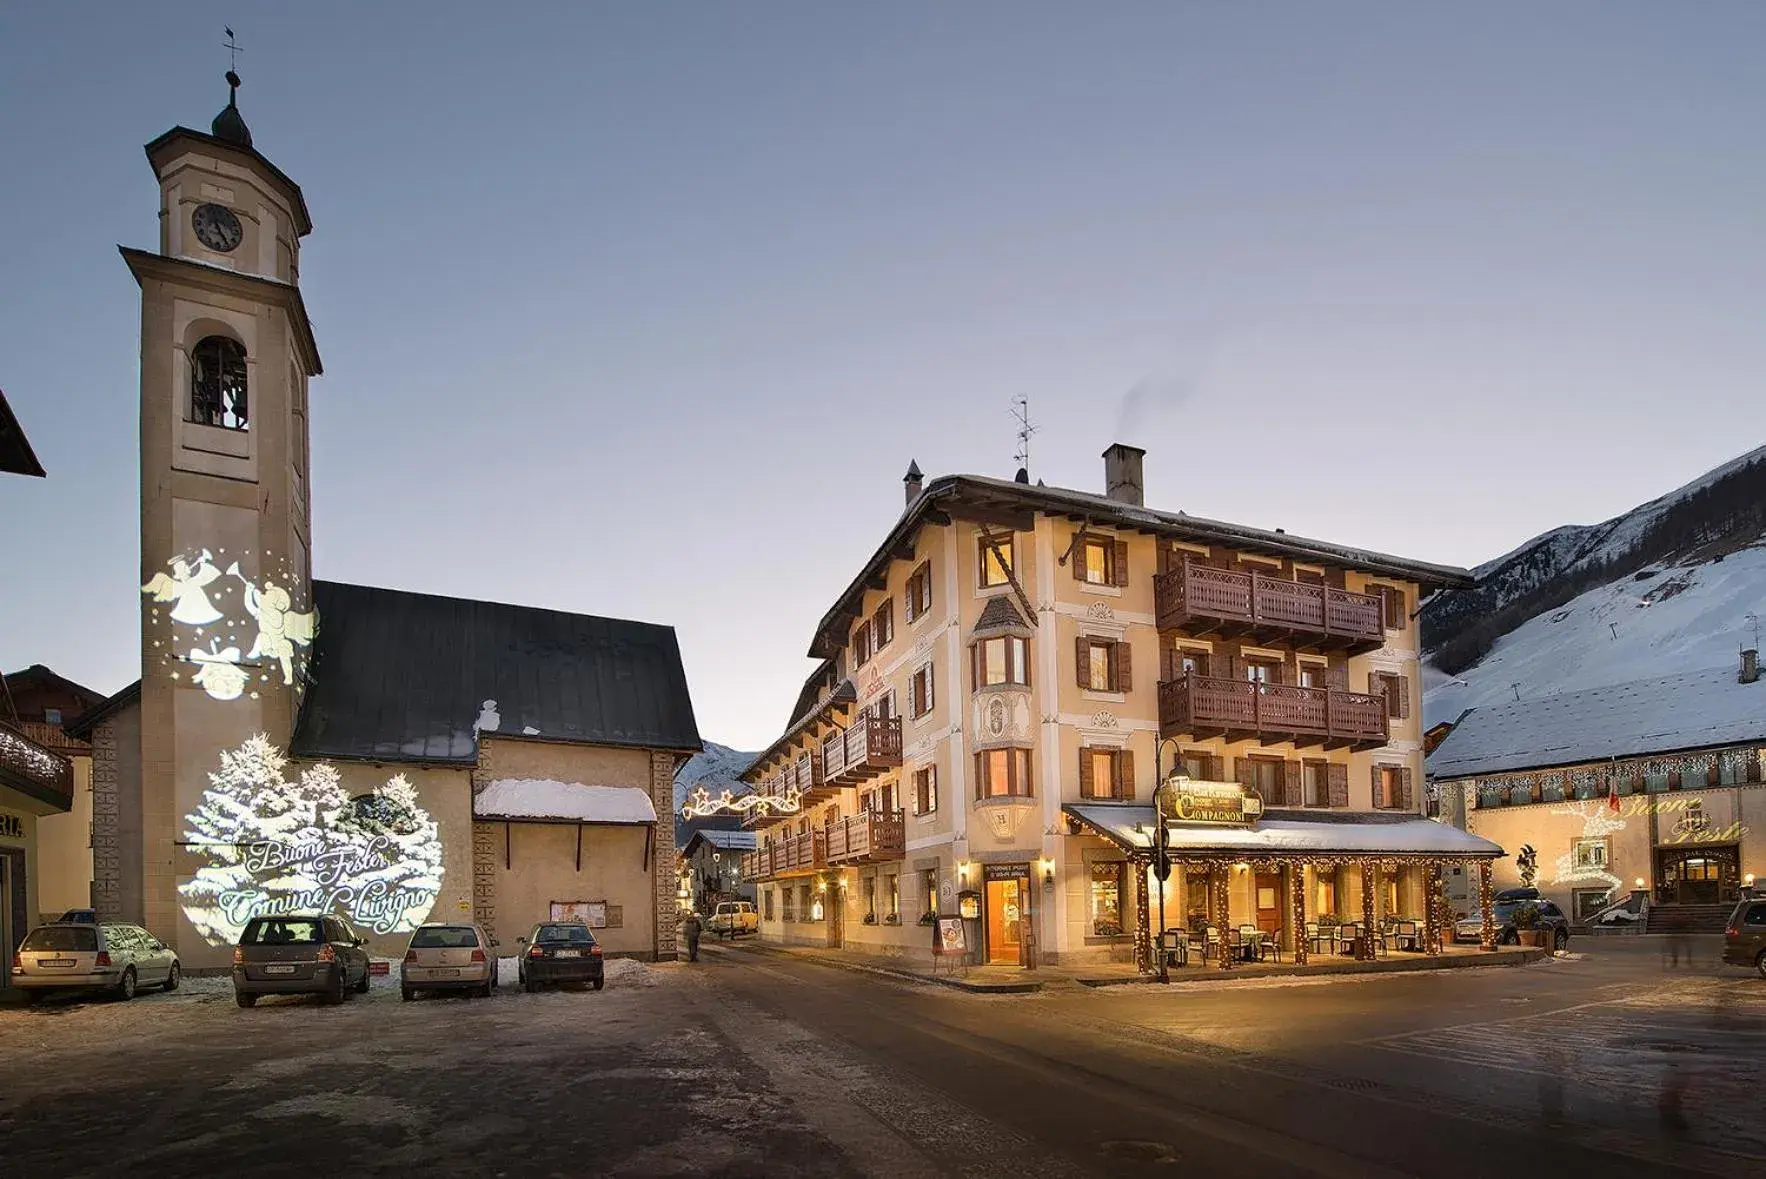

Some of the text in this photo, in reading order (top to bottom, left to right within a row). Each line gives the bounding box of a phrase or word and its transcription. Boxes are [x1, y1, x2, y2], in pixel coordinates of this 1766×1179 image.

[246, 835, 389, 885] Buone Feste
[218, 888, 325, 927] Comune
[355, 880, 431, 935] Livigno
